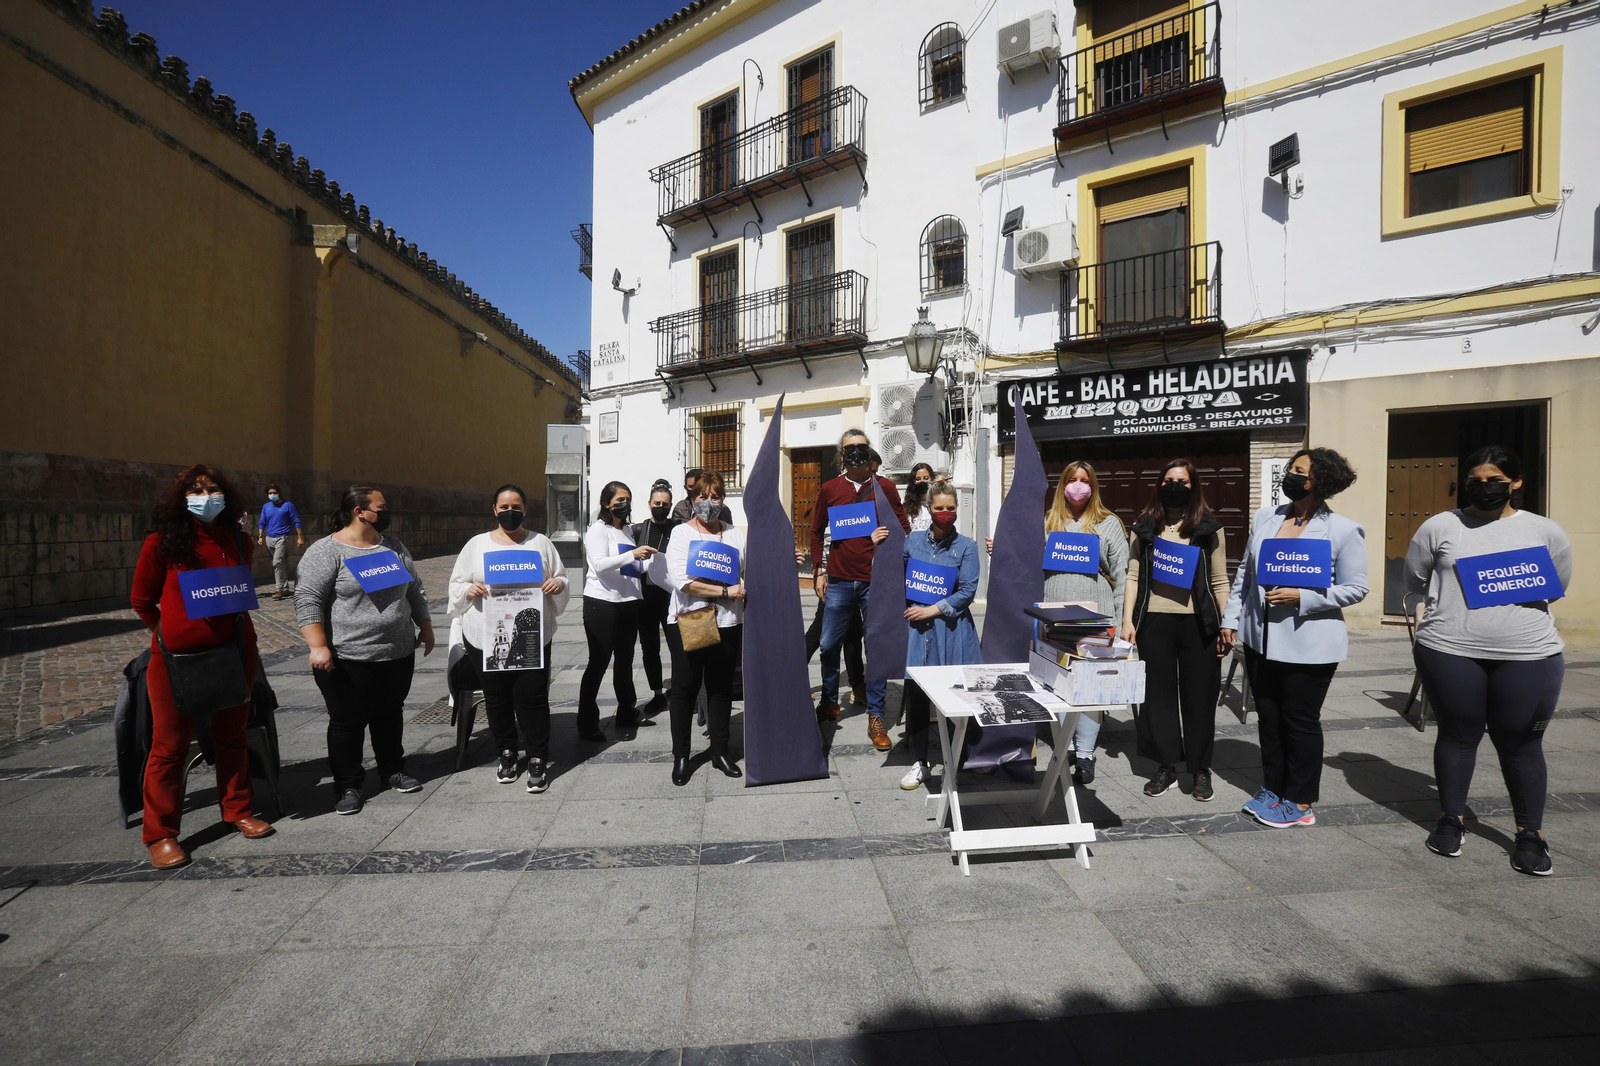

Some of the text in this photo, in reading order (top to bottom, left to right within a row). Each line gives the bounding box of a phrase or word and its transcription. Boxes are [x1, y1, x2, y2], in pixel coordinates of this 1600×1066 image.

[599, 341, 620, 351] PLAZA
[1464, 340, 1471, 350] 3
[593, 354, 626, 367] CATALINA
[599, 348, 620, 359] SANTA
[1007, 380, 1060, 408] CAFE
[1080, 373, 1126, 401] BAR
[1148, 355, 1297, 396] HELADERIA
[1043, 390, 1243, 420] MEZQUITA
[1113, 414, 1193, 427] BOCADILLOS
[1204, 407, 1293, 421] DESAYUNOS
[1113, 422, 1198, 435] SANDWICHES
[1209, 416, 1293, 429] BREAKFAST
[835, 515, 871, 528] ARTESANÍA
[1054, 541, 1089, 553] Museos
[698, 550, 732, 564] PEQUEÑO
[1051, 551, 1090, 563] Privados
[1153, 548, 1184, 565] Museos
[1276, 551, 1310, 562] Guías
[358, 563, 400, 579] HOSPEDAJE
[489, 562, 537, 571] HOSTELERÍA
[695, 559, 732, 574] COMERCIO
[1152, 559, 1184, 576] rivados
[1265, 562, 1322, 574] Turísticos
[1477, 562, 1539, 581] PEQUEÑO
[911, 570, 945, 585] TABLAOS
[1478, 575, 1547, 594] COMERCIO
[191, 583, 249, 600] HOSPEDAJE
[905, 579, 948, 596] FLAMENCOS
